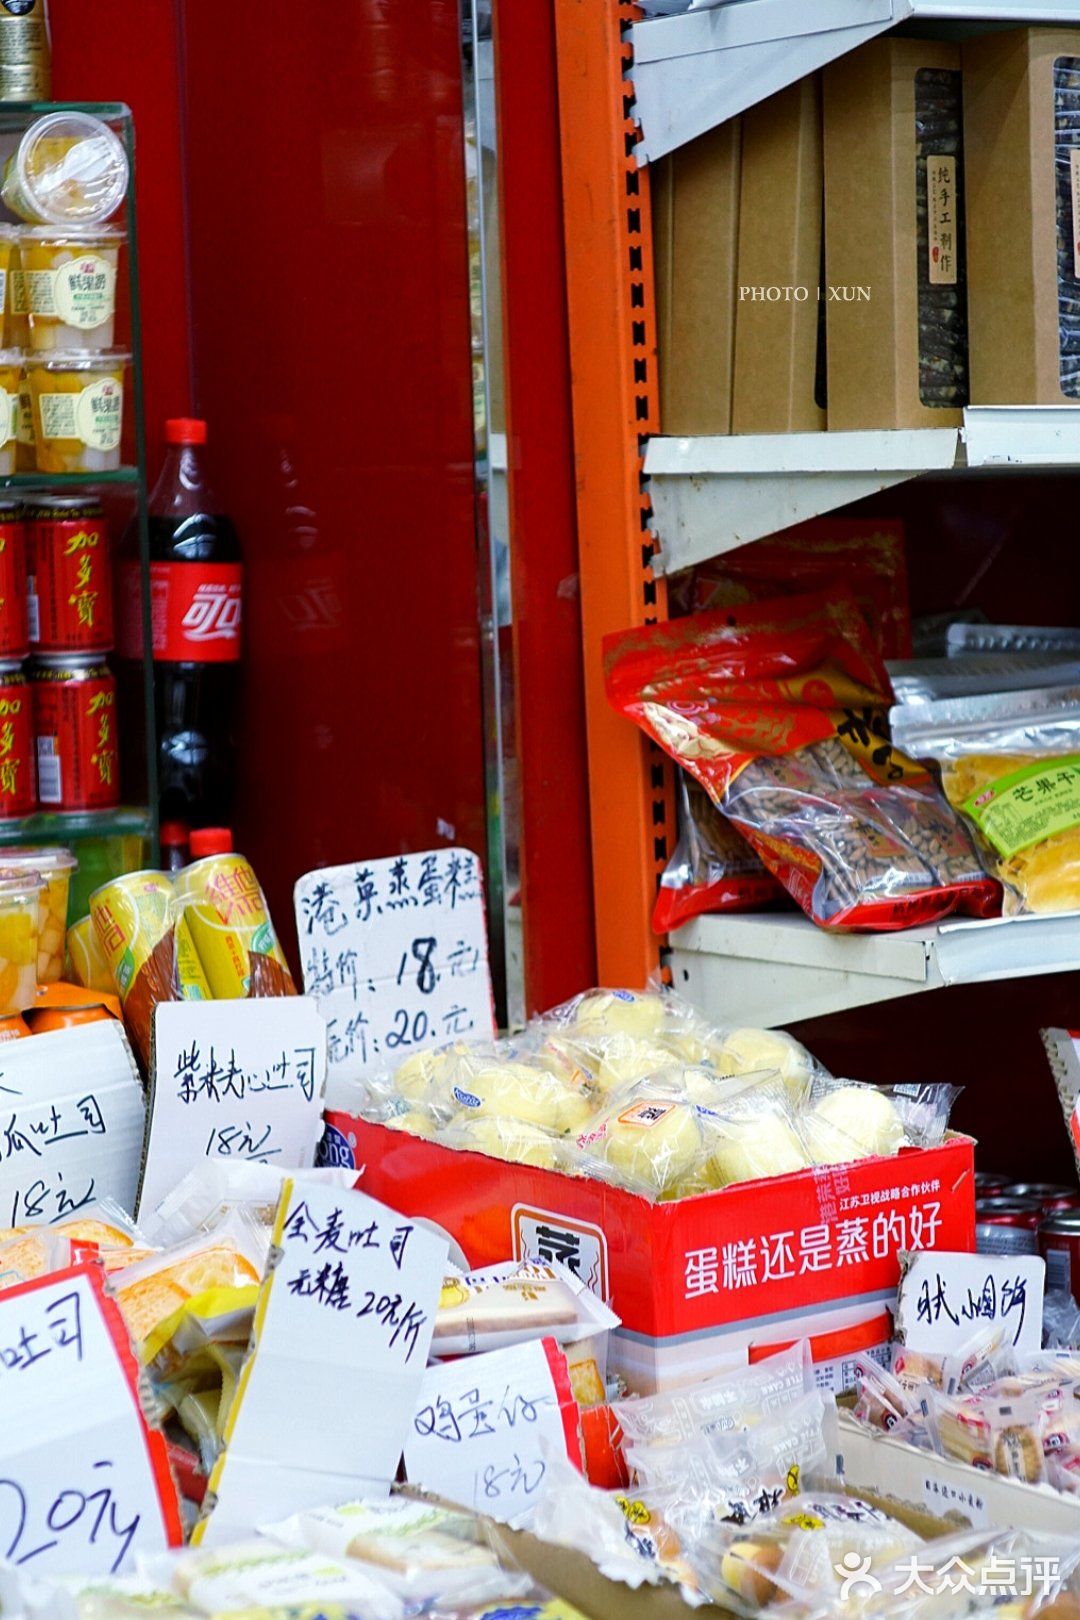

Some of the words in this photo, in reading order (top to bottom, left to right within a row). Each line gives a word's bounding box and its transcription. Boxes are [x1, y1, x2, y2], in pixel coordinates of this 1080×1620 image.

[938, 166, 952, 272] 纯手工制作
[1012, 771, 1075, 802] 芒果干
[318, 1138, 352, 1170] ong
[839, 1179, 941, 1212] 江苏卫视战略合作伙伴
[283, 1201, 414, 1270] 全麦吐司
[684, 1201, 943, 1299] 蛋糕还是蒸的好
